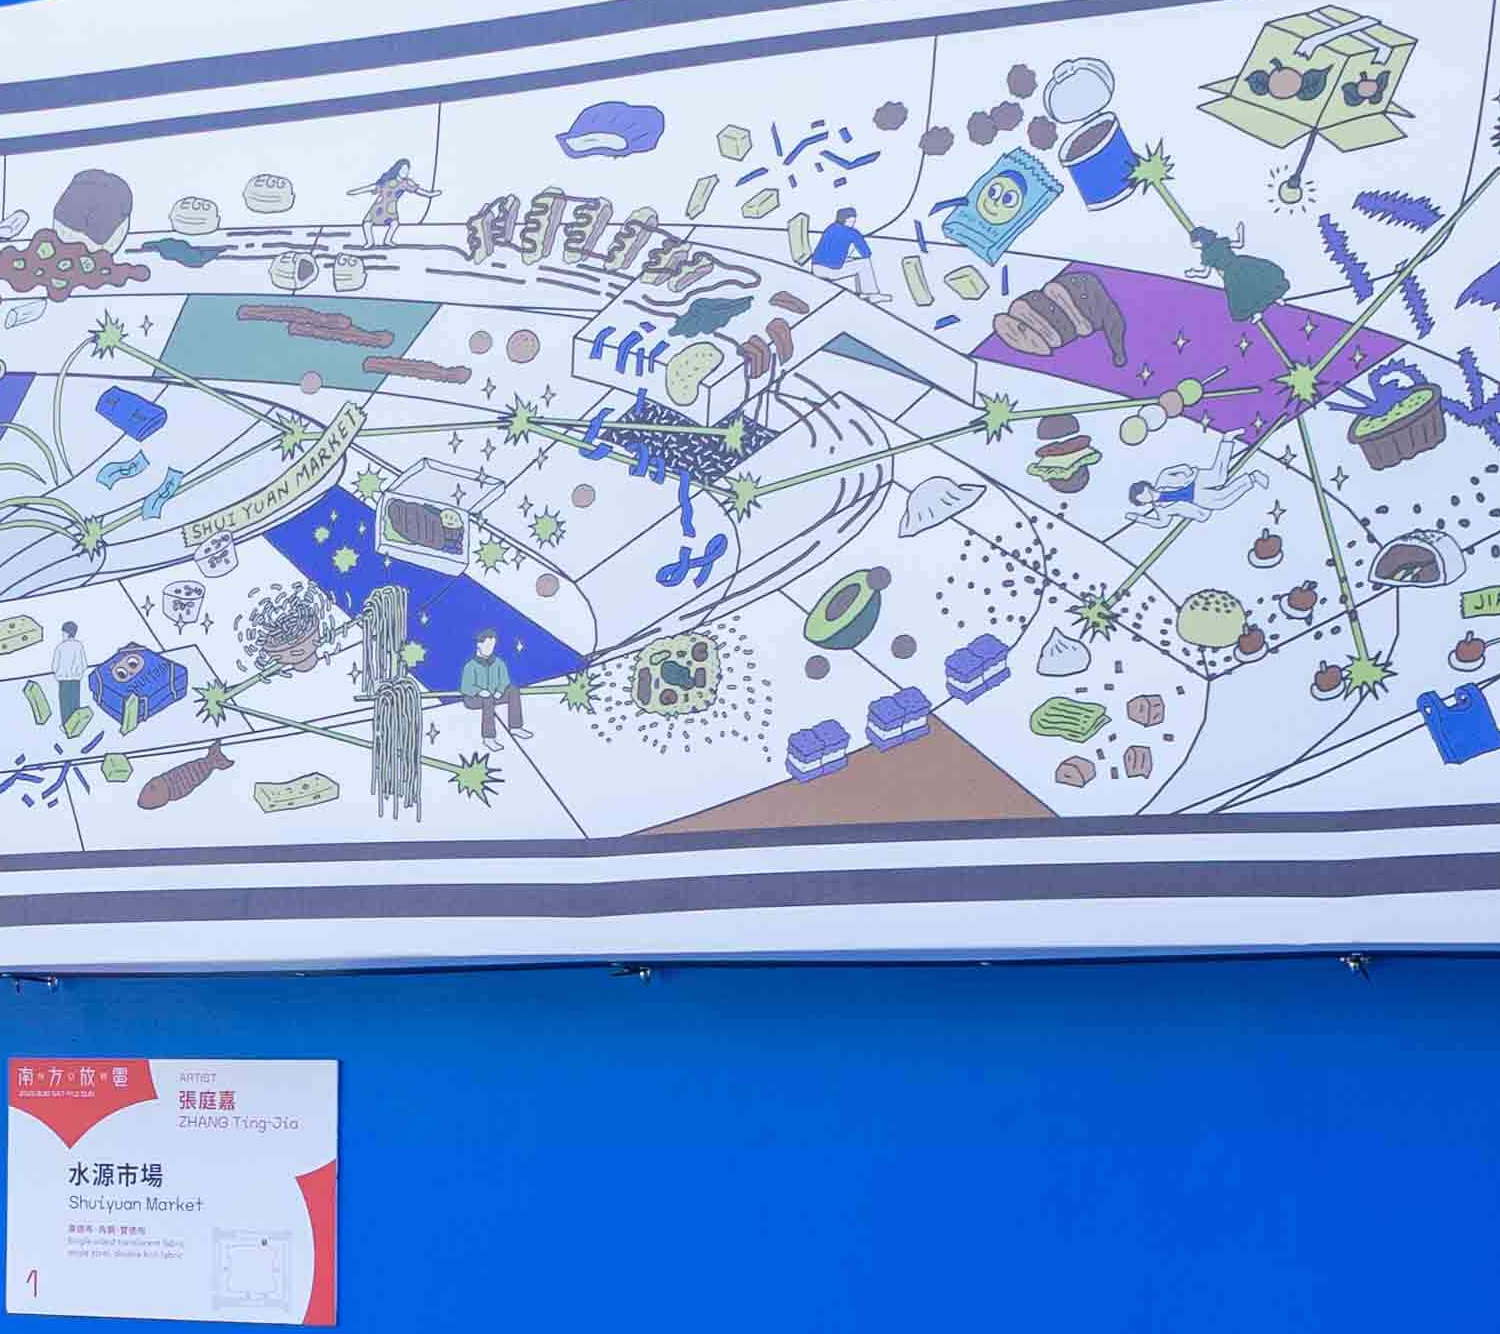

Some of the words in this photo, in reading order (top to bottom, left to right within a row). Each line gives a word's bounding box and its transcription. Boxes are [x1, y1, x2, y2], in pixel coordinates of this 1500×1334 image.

[254, 178, 288, 188] EGG
[180, 199, 213, 211] EGG
[191, 513, 239, 540] SHUI
[241, 481, 290, 518] YUAN
[295, 408, 358, 488] MARKET
[178, 1090, 236, 1110] 張庭嘉
[178, 1115, 229, 1129] ZHANG
[232, 1116, 300, 1133] Ting-Jia
[68, 1161, 164, 1187] 水源市場
[68, 1195, 142, 1214] Shuiyuan
[145, 1196, 204, 1212] Market
